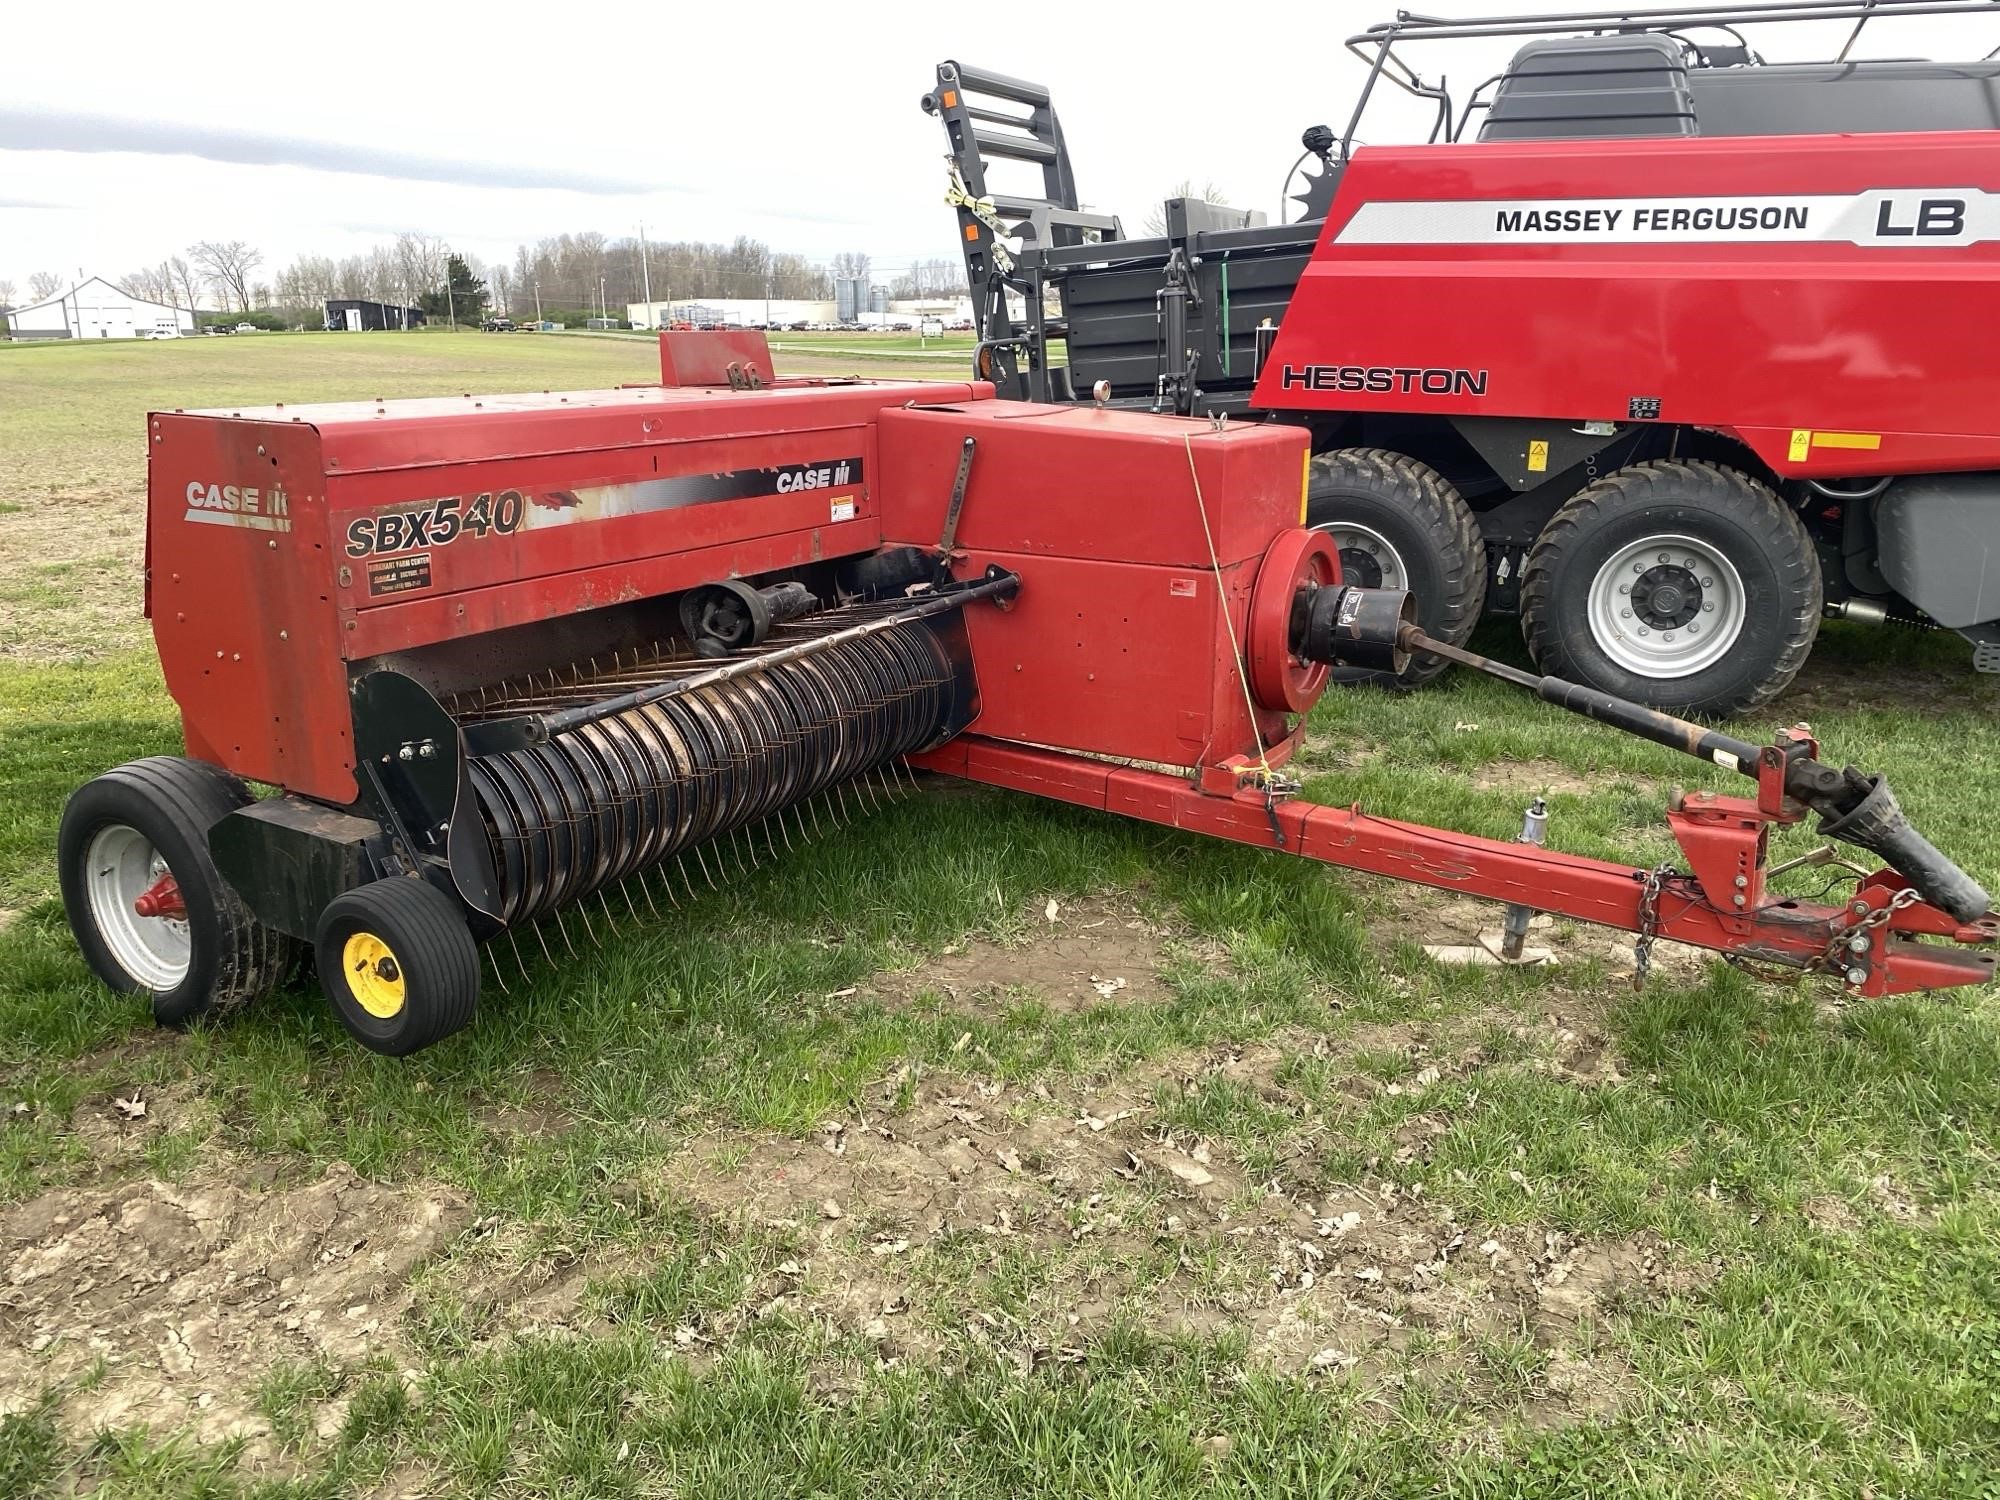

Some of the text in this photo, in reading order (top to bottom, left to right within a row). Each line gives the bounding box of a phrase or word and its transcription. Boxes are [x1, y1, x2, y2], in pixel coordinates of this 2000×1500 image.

[1495, 206, 1809, 233] MASSEY FERGUSON
[1875, 199, 1967, 237] LB
[1282, 365, 1489, 396] HESSTON
[776, 467, 831, 494] CASE
[186, 481, 260, 513] CASE
[345, 489, 525, 558] SBX540
